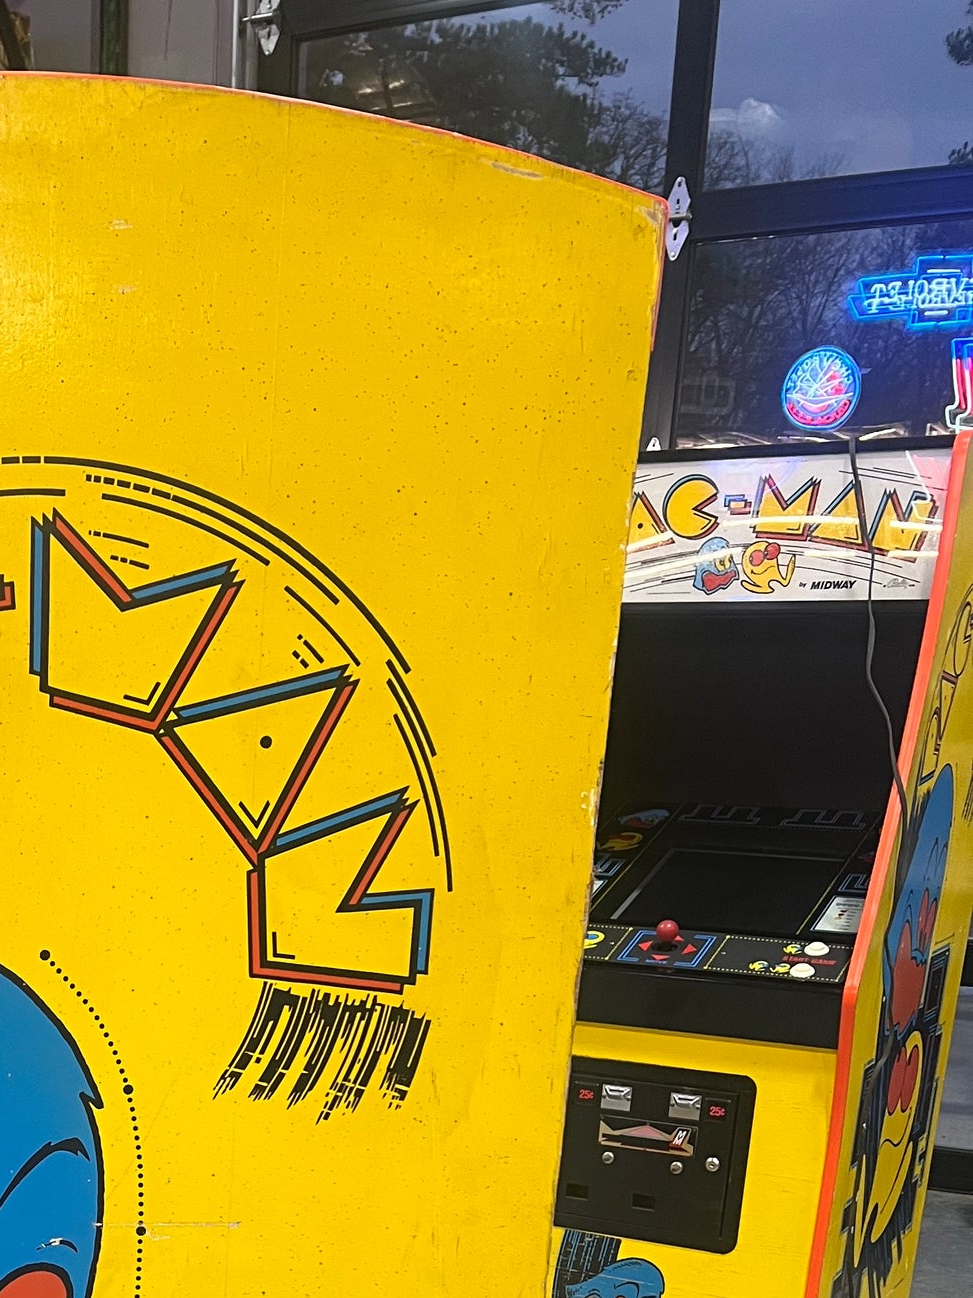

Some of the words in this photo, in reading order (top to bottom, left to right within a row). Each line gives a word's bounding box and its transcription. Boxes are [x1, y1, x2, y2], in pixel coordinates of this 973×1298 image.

[625, 473, 938, 563] AC-MAN
[810, 580, 856, 590] MIDWAY
[579, 1089, 594, 1100] 25¢
[709, 1105, 725, 1117] 25¢
